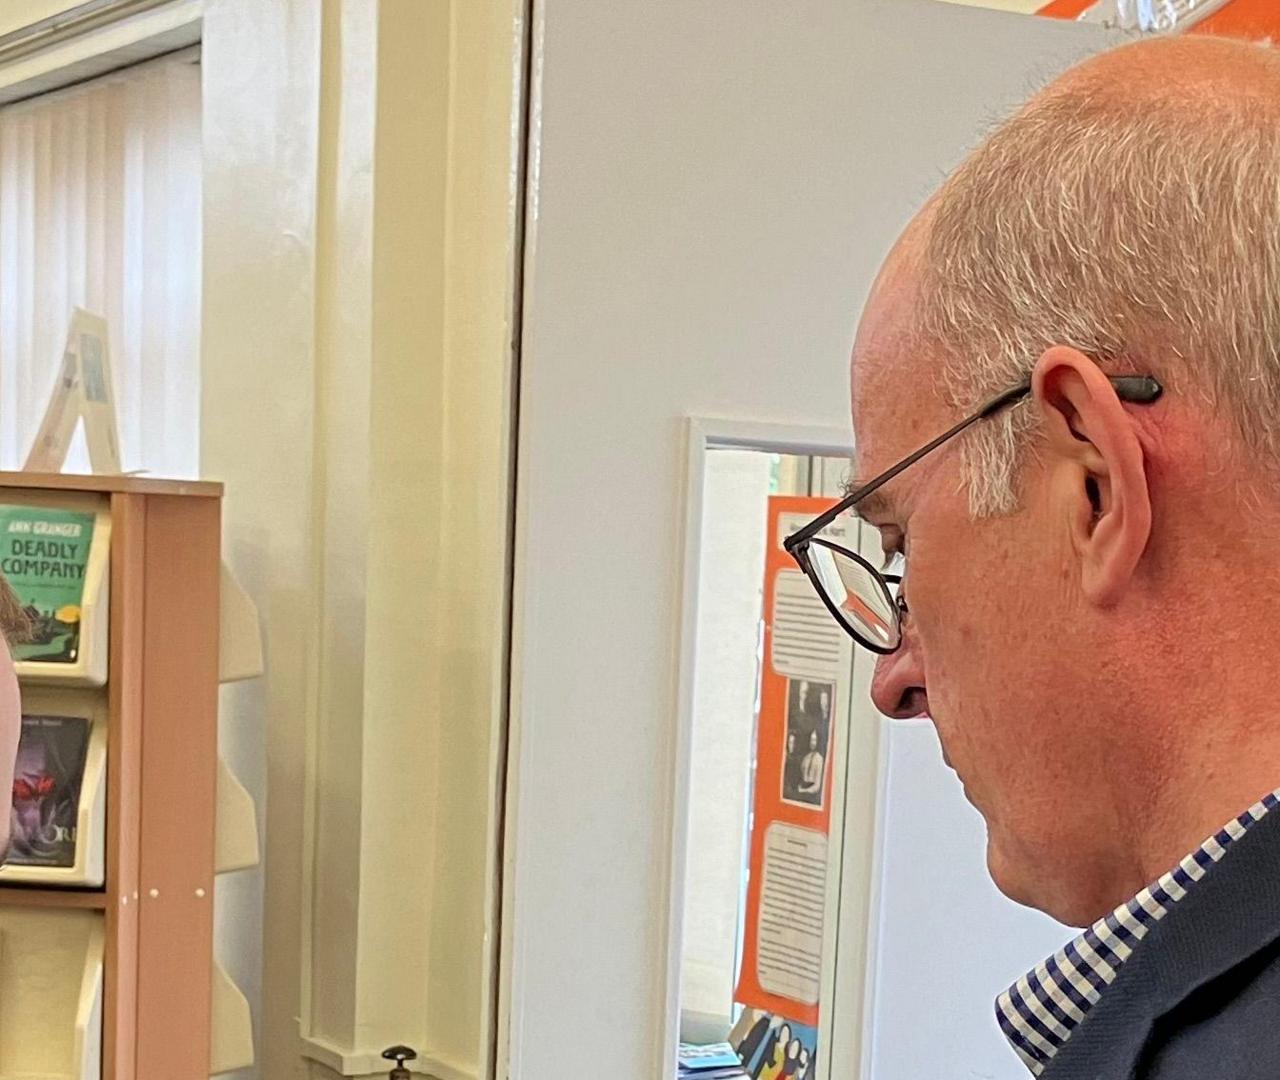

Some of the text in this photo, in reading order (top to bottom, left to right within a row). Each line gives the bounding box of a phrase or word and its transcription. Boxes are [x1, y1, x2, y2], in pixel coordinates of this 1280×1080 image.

[32, 521, 82, 537] GRANGER
[11, 539, 79, 559] DEADLY
[1, 559, 85, 579] COMPANY
